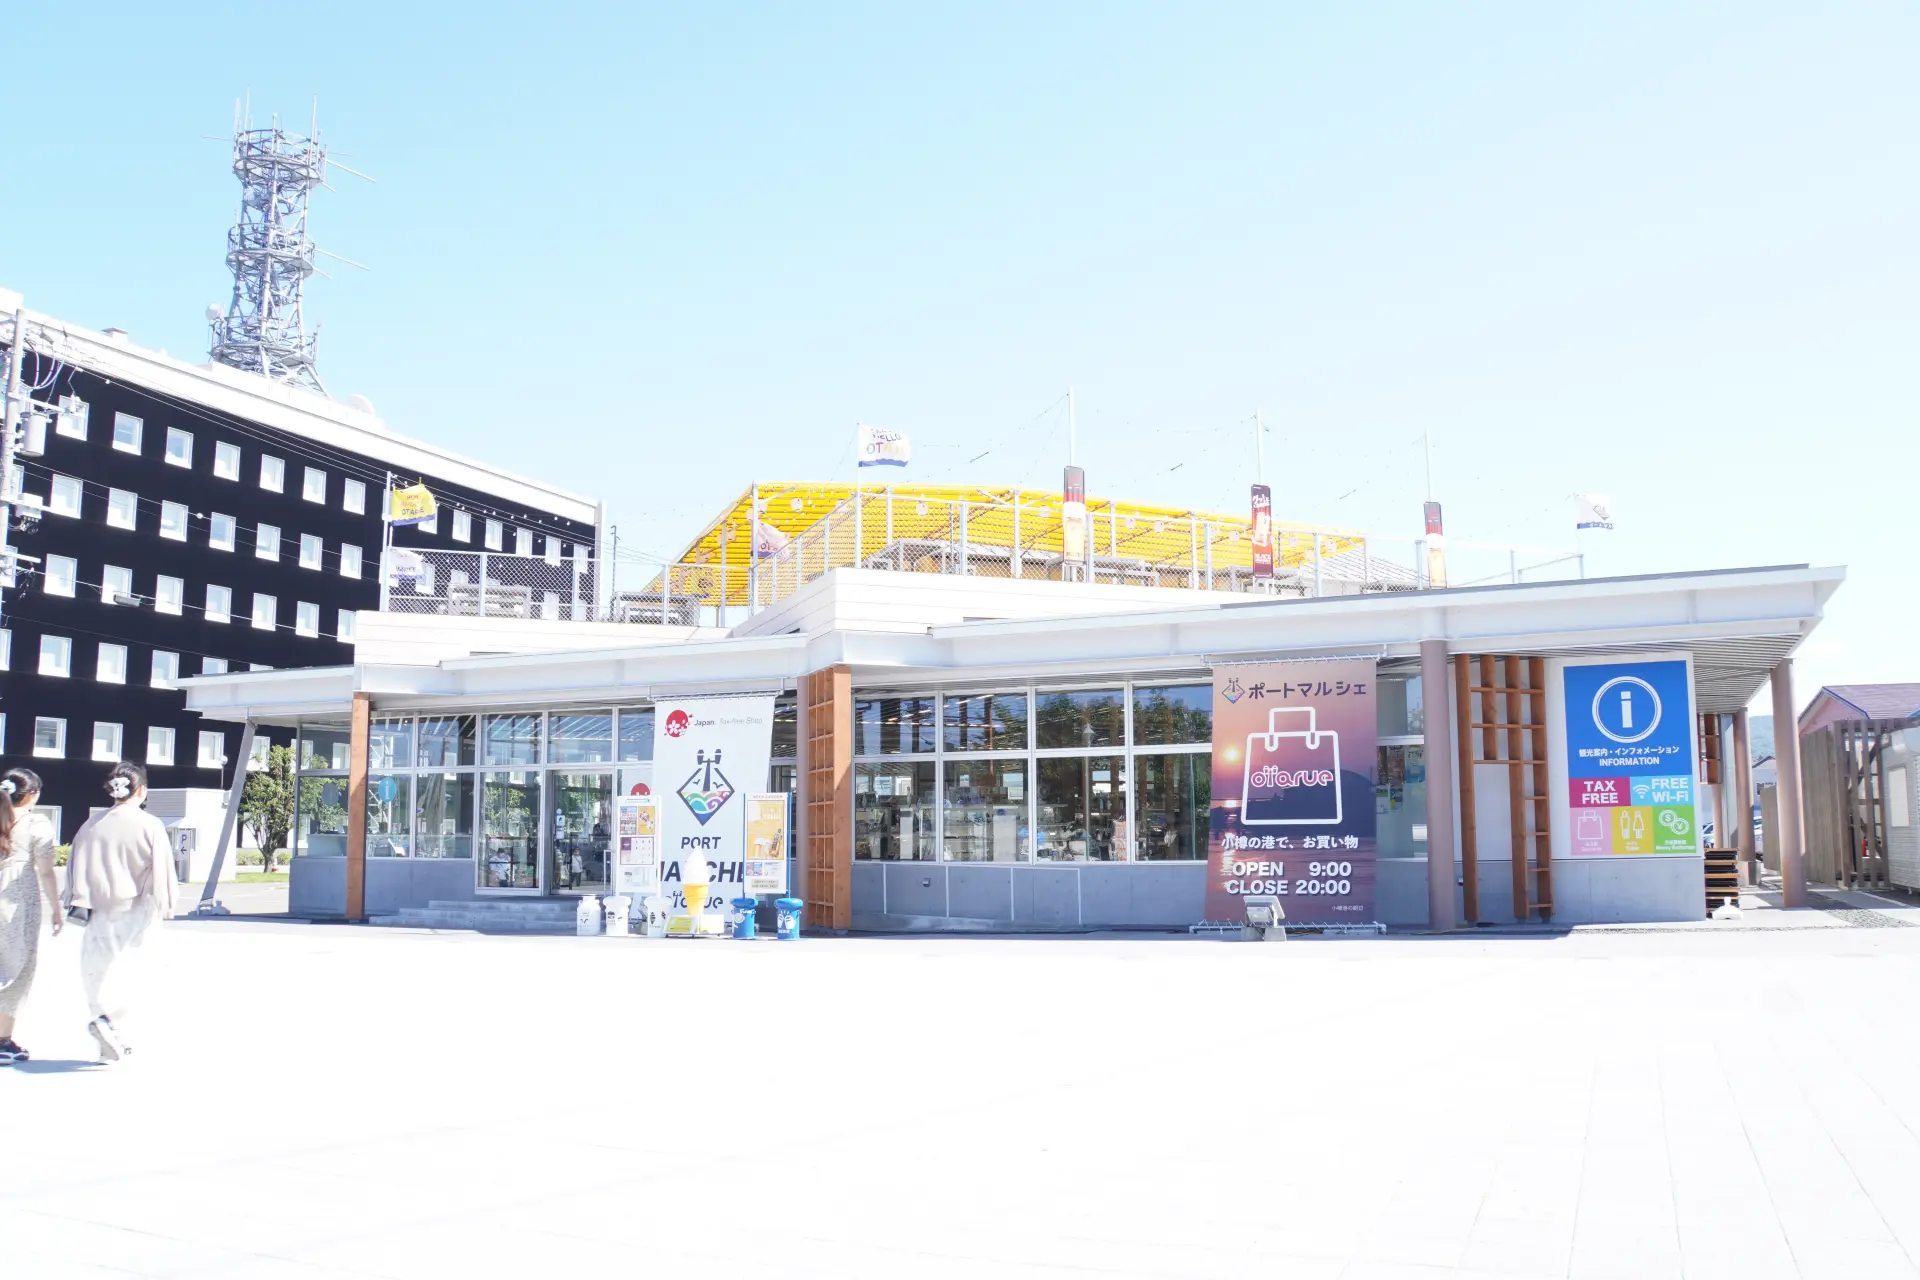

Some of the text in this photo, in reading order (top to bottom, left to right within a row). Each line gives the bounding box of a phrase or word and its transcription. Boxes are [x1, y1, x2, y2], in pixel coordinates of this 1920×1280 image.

[1249, 680, 1367, 699] ポートマルシェ
[1579, 746, 1680, 757] 観光案内・インフォメーション
[1599, 757, 1660, 766] INFORMATION
[1585, 781, 1615, 792] TAX
[1651, 777, 1689, 790] FREE
[1582, 792, 1618, 805] FREE
[1652, 790, 1689, 803] Wi-Fi
[181, 834, 188, 845] P
[681, 836, 722, 850] PORT
[1232, 862, 1352, 877] OPEN 9:00
[1226, 880, 1351, 895] CLOSE 20:00
